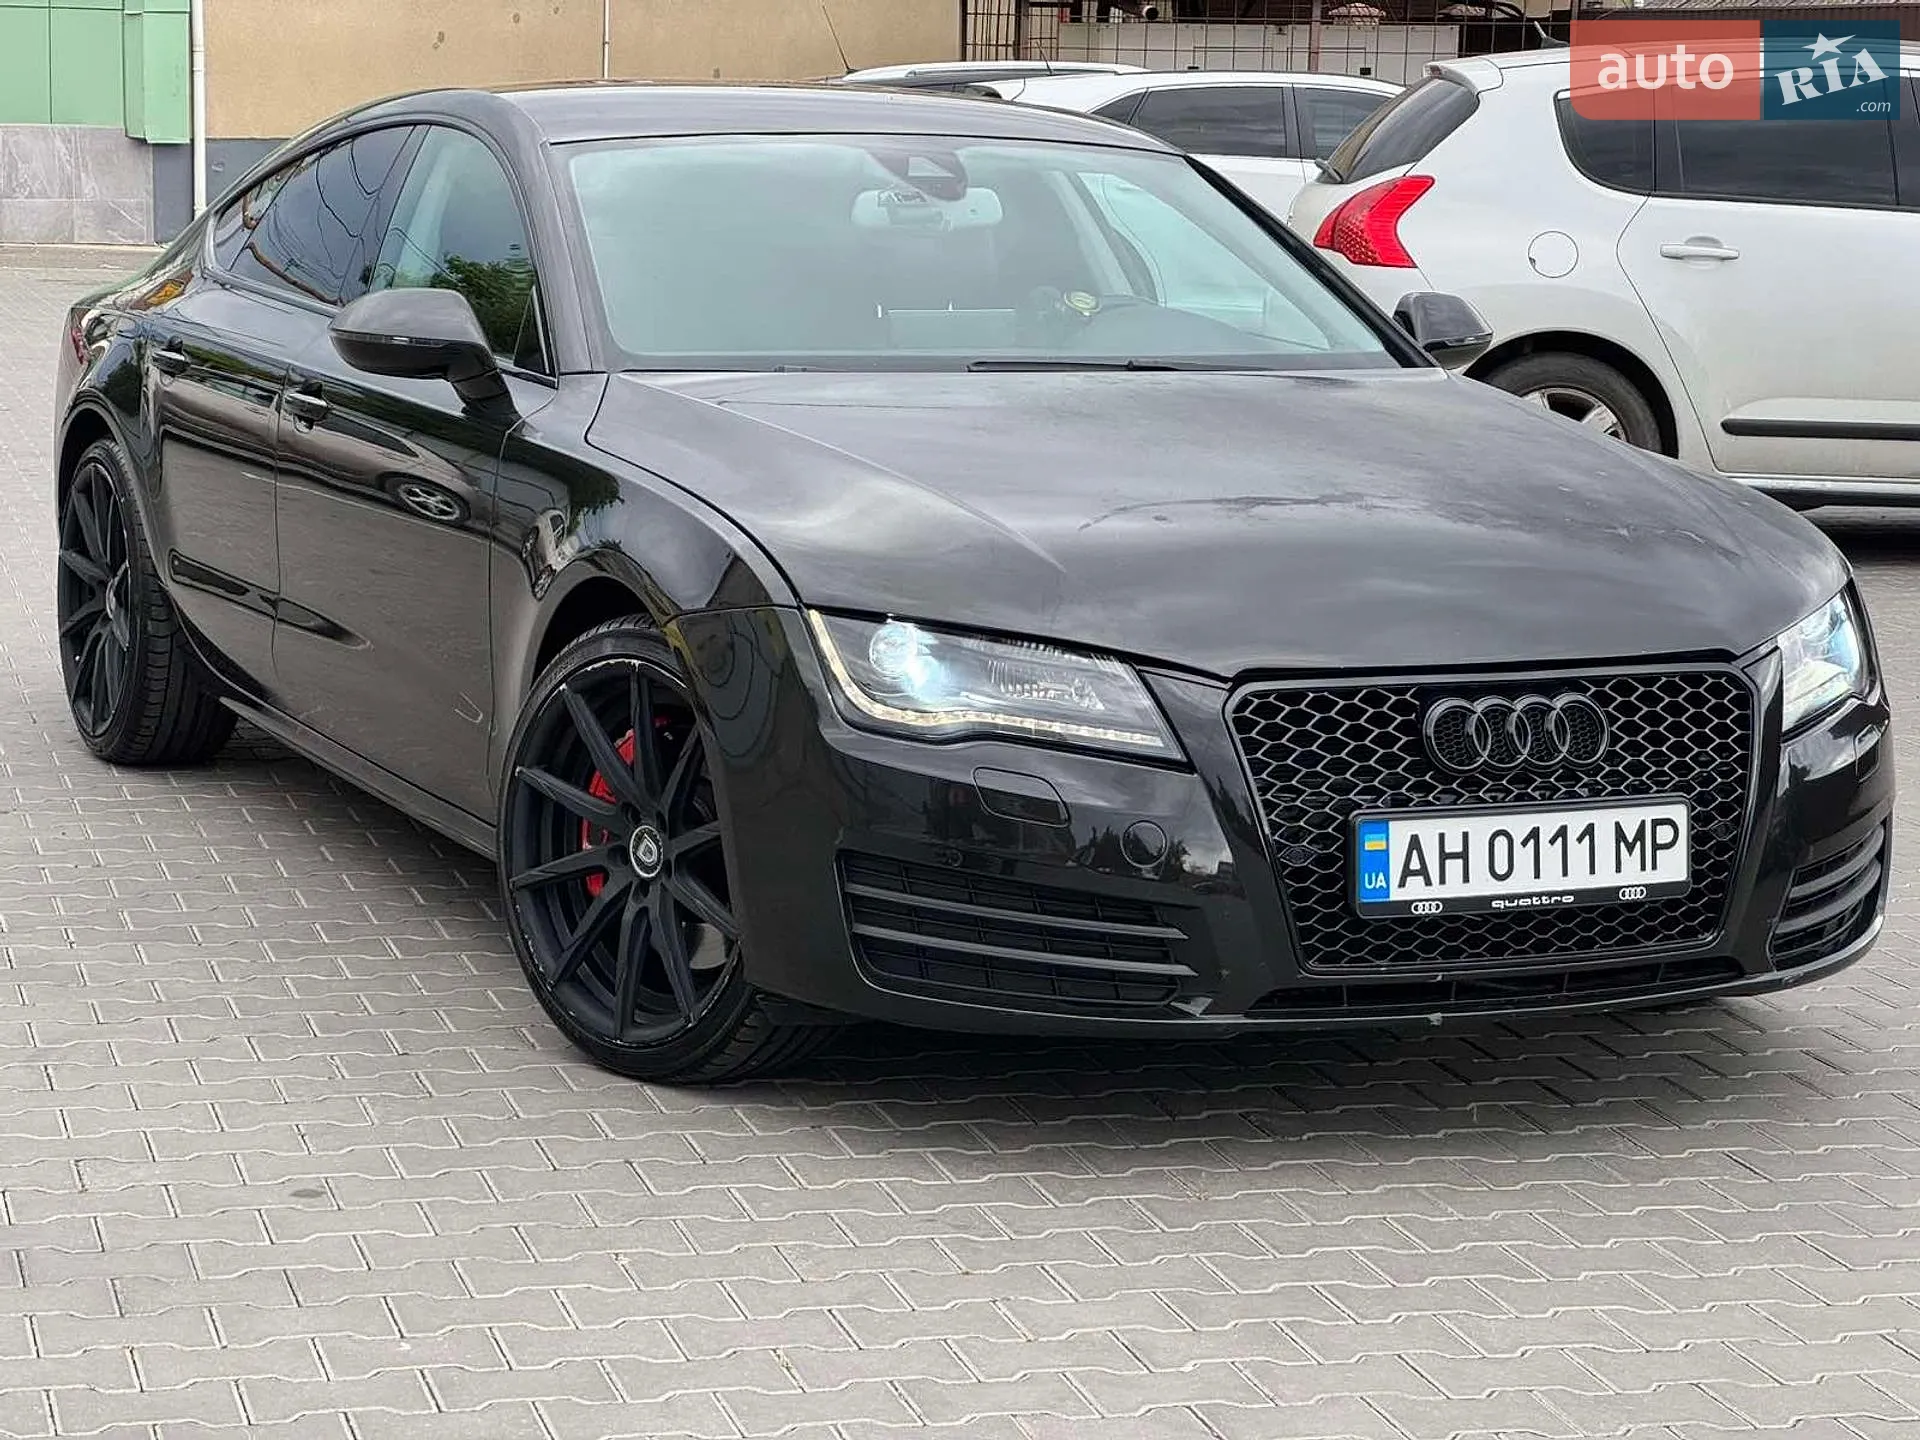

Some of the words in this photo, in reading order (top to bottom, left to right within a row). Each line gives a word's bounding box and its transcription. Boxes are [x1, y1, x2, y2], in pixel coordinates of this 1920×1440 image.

[1397, 831, 1470, 889] AH
[1488, 822, 1596, 882] 0111
[1614, 817, 1680, 874] MP
[1364, 871, 1387, 890] UA
[1491, 894, 1575, 910] quattro
